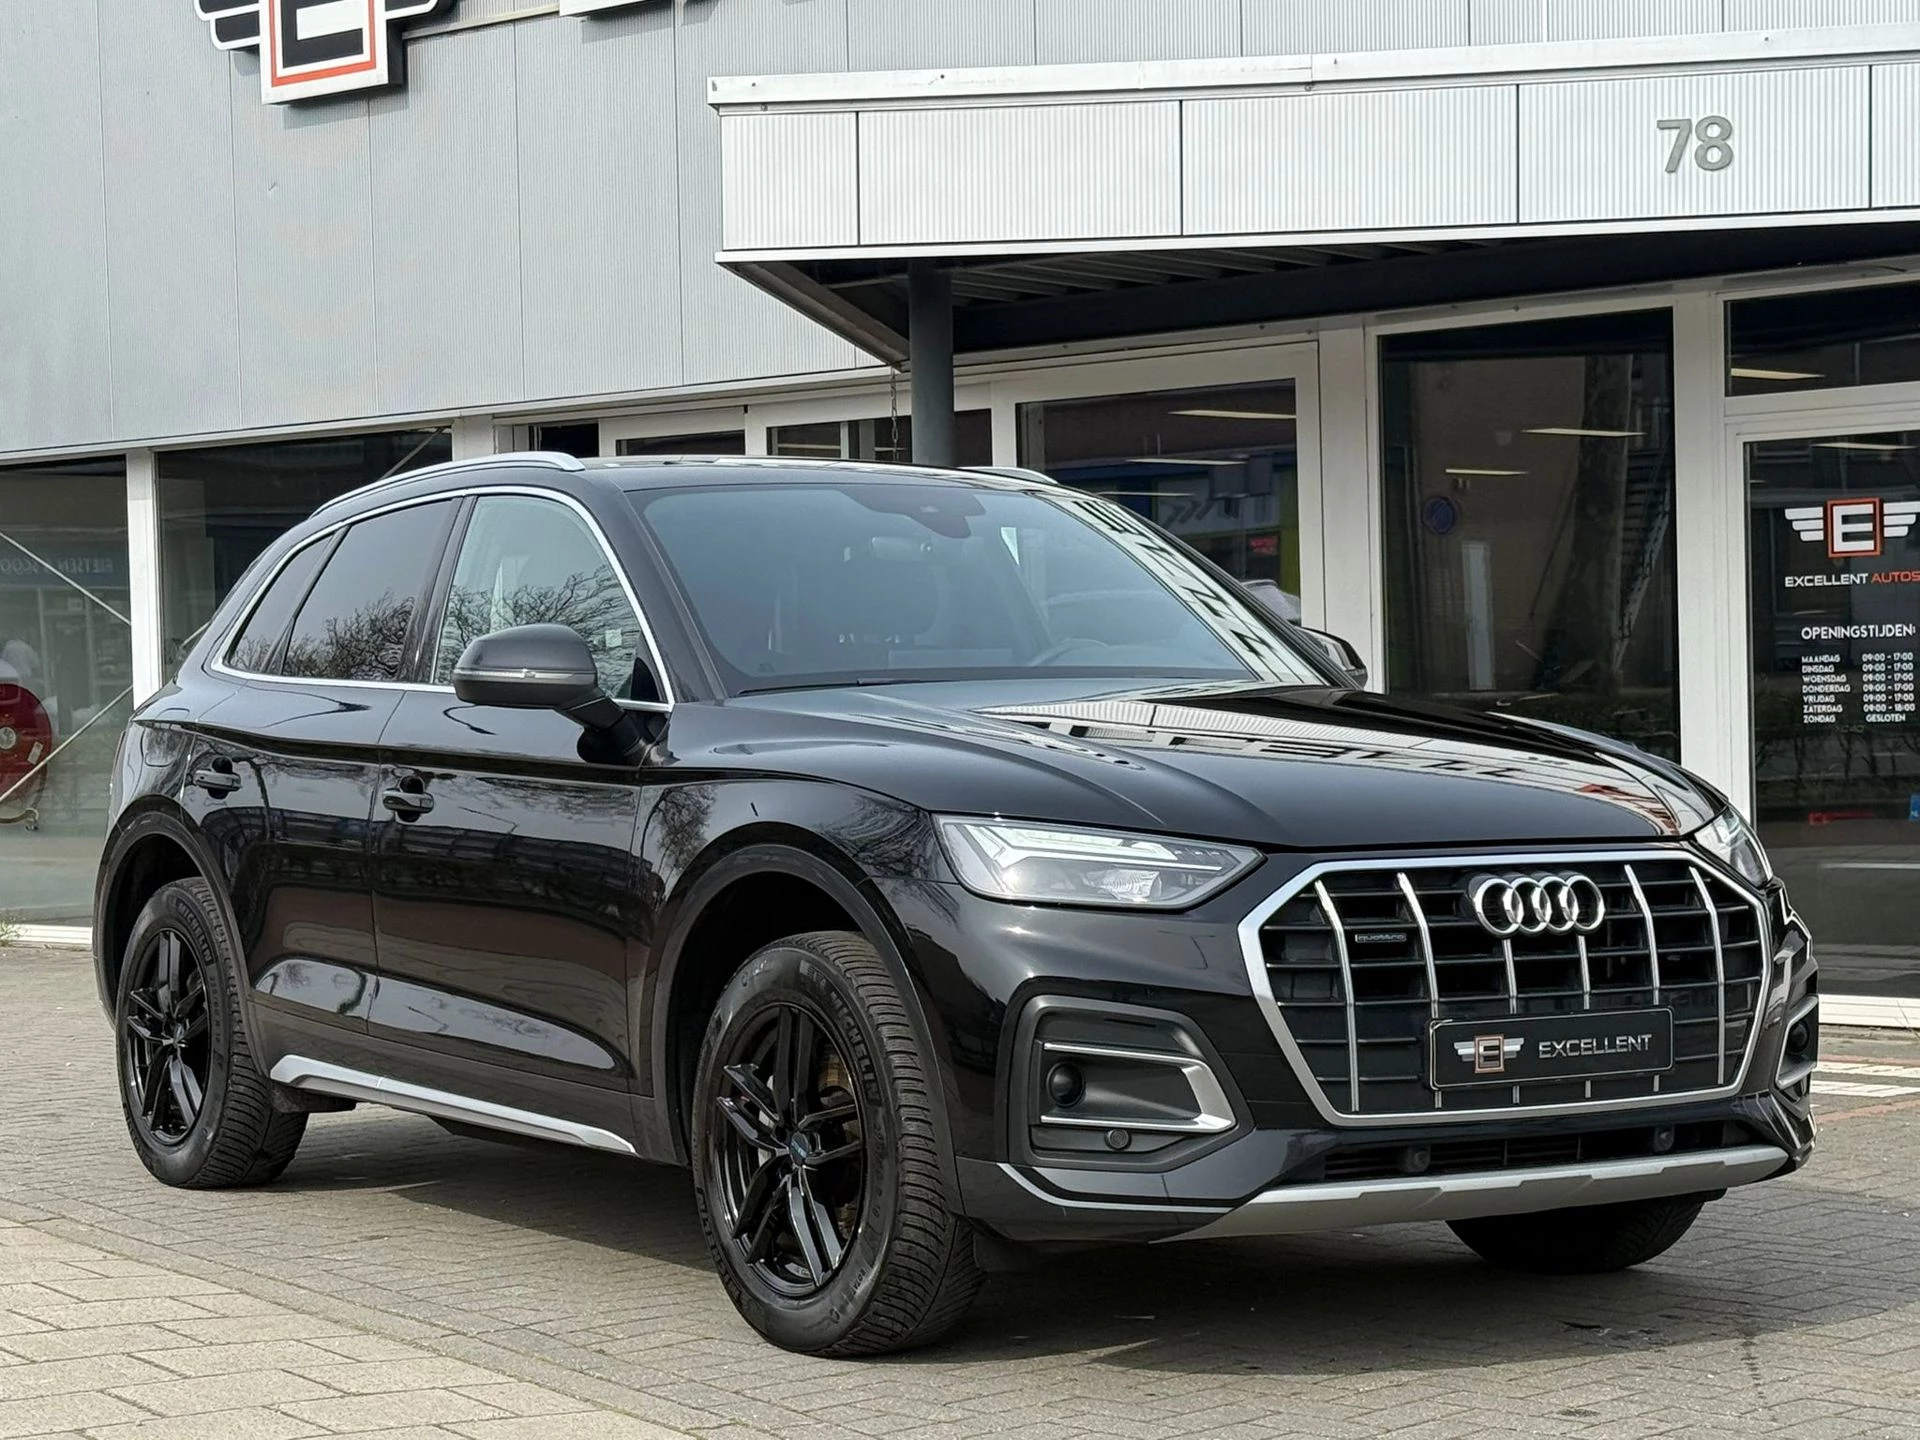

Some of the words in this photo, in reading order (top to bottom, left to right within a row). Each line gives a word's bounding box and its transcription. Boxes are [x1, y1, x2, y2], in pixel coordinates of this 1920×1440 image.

[1656, 115, 1734, 173] 78
[1832, 502, 1875, 553] E
[1785, 573, 1868, 588] EXCELLENT
[1871, 571, 1920, 584] AUTOS
[1801, 624, 1916, 640] OPENINGSTIJDEN:
[1801, 654, 1841, 663] MAANDAG
[1801, 664, 1835, 673] DINSDAG
[1802, 674, 1847, 683] WOENSDAG
[1802, 684, 1851, 693] DONDERDAG
[1802, 695, 1835, 703] VRIJDAG
[1803, 704, 1843, 713] ZATERDAG
[1803, 714, 1836, 723] ZONDAG
[1866, 713, 1906, 722] GESLOTEN
[1538, 1034, 1653, 1059] EXCELLENT
